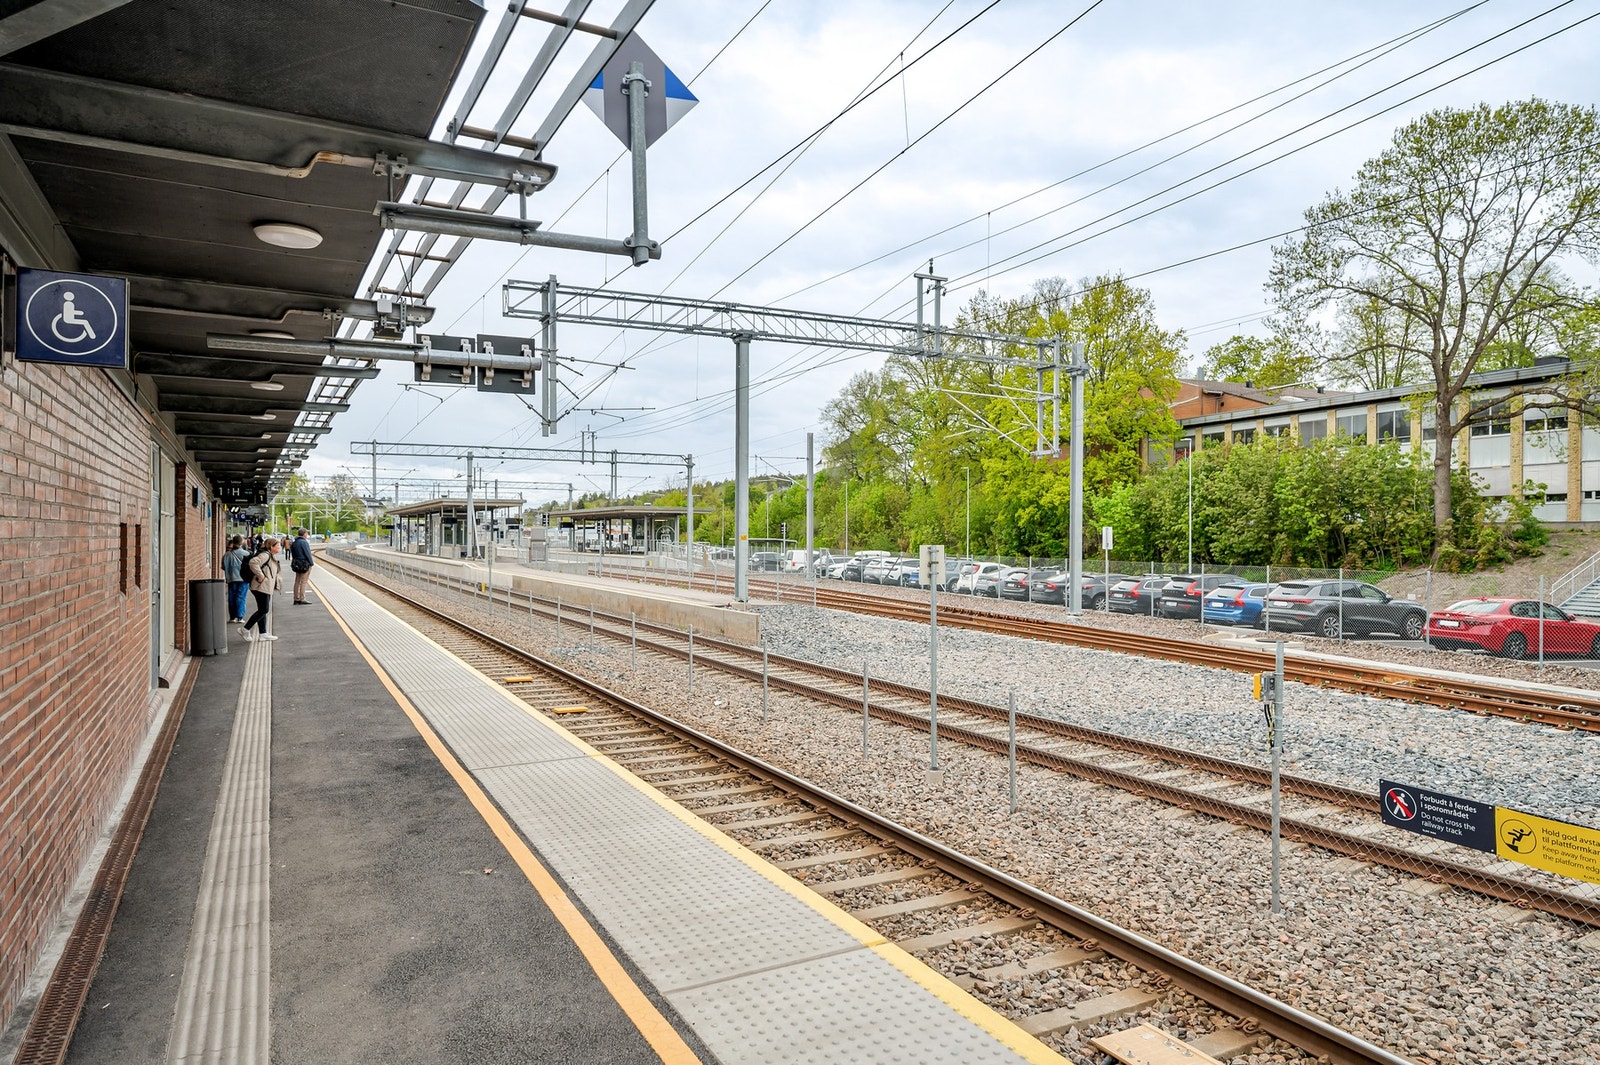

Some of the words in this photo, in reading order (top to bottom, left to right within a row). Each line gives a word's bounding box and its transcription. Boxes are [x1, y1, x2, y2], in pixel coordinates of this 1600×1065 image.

[232, 488, 240, 496] H
[1420, 794, 1448, 806] Forbudt
[1454, 802, 1477, 814] ferdes
[1424, 804, 1469, 819] sporområdet
[1422, 821, 1445, 832] railway
[1446, 826, 1463, 836] track
[1432, 815, 1444, 823] not
[1445, 819, 1462, 828] cross
[1463, 822, 1476, 832] the
[1542, 827, 1560, 837] Hold
[1562, 833, 1577, 842] god
[1579, 838, 1600, 847] avsta
[1542, 846, 1559, 855] Keep
[1561, 851, 1578, 860] away
[1579, 855, 1597, 864] from
[1555, 857, 1584, 869] platform
[1586, 866, 1600, 874] edg
